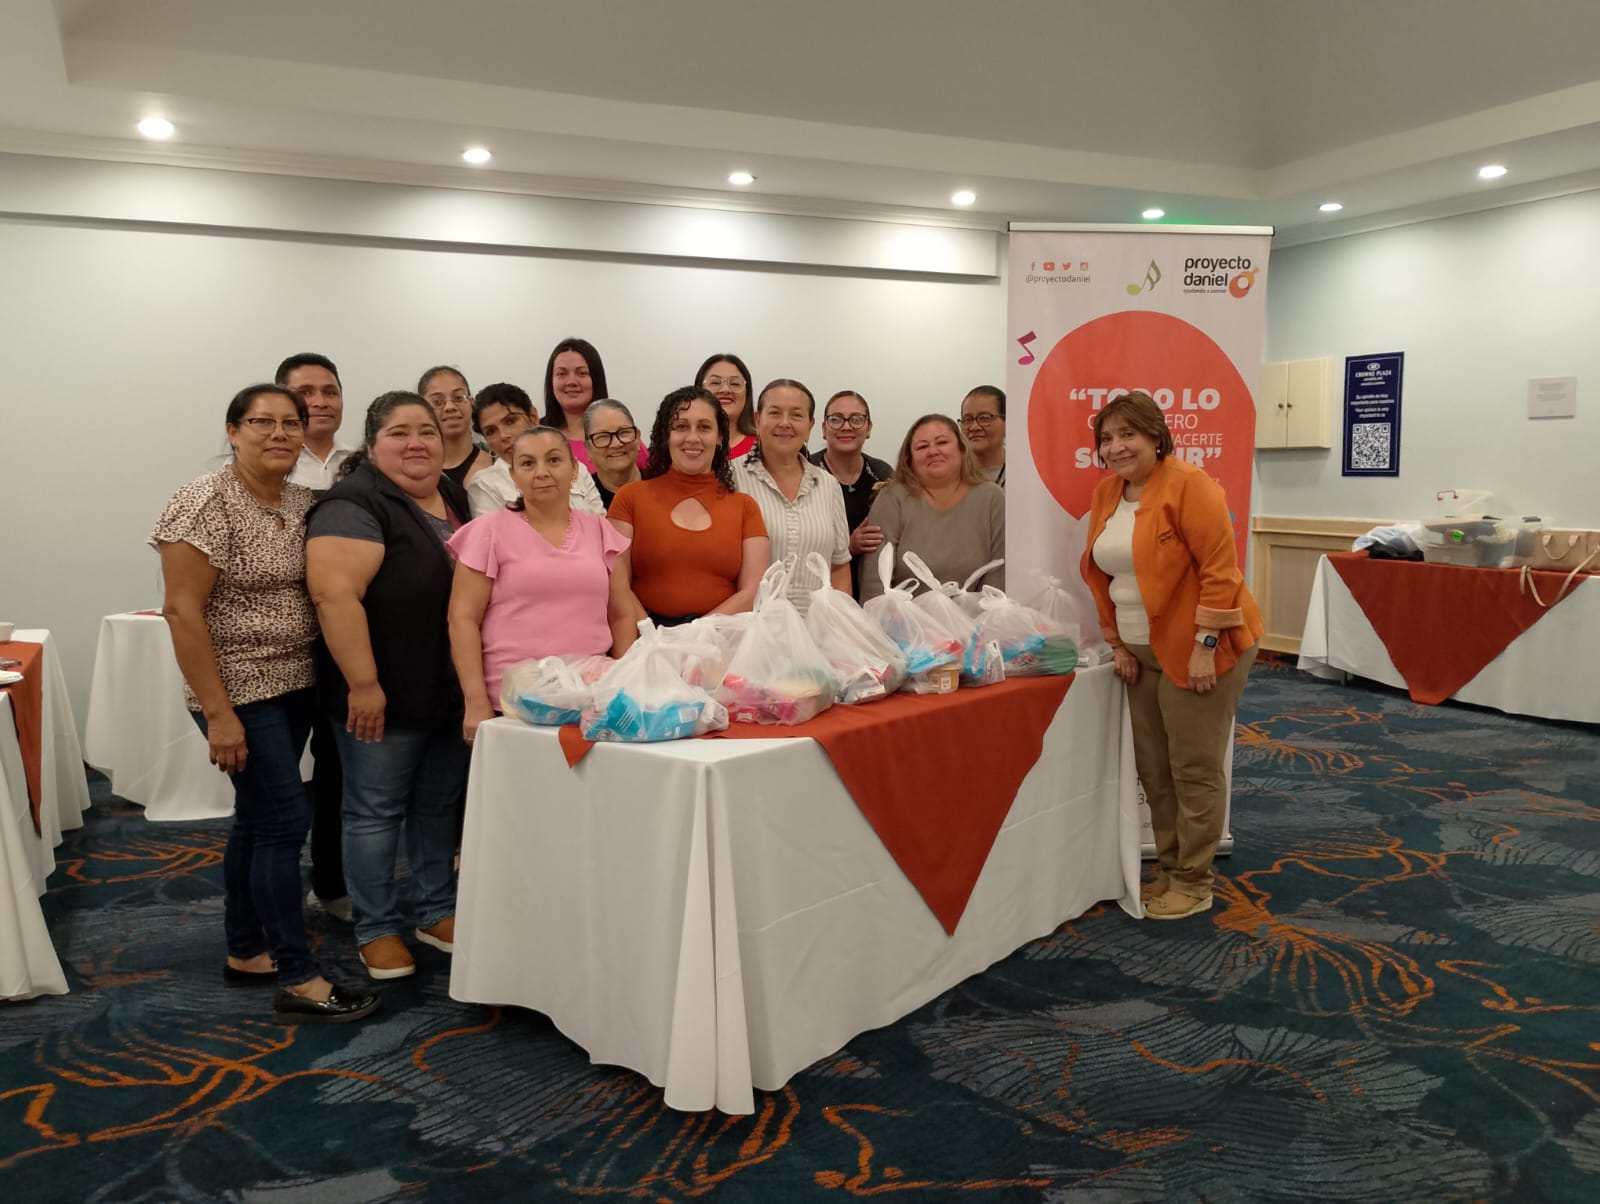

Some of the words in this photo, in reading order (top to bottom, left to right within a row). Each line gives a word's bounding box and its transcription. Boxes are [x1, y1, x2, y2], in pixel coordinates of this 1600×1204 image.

[1184, 256, 1251, 272] proyecto
[1025, 274, 1091, 284] @proyectodaniel
[1183, 272, 1228, 286] daniel
[1181, 388, 1221, 410] LO
[1171, 433, 1224, 446] ACERTE
